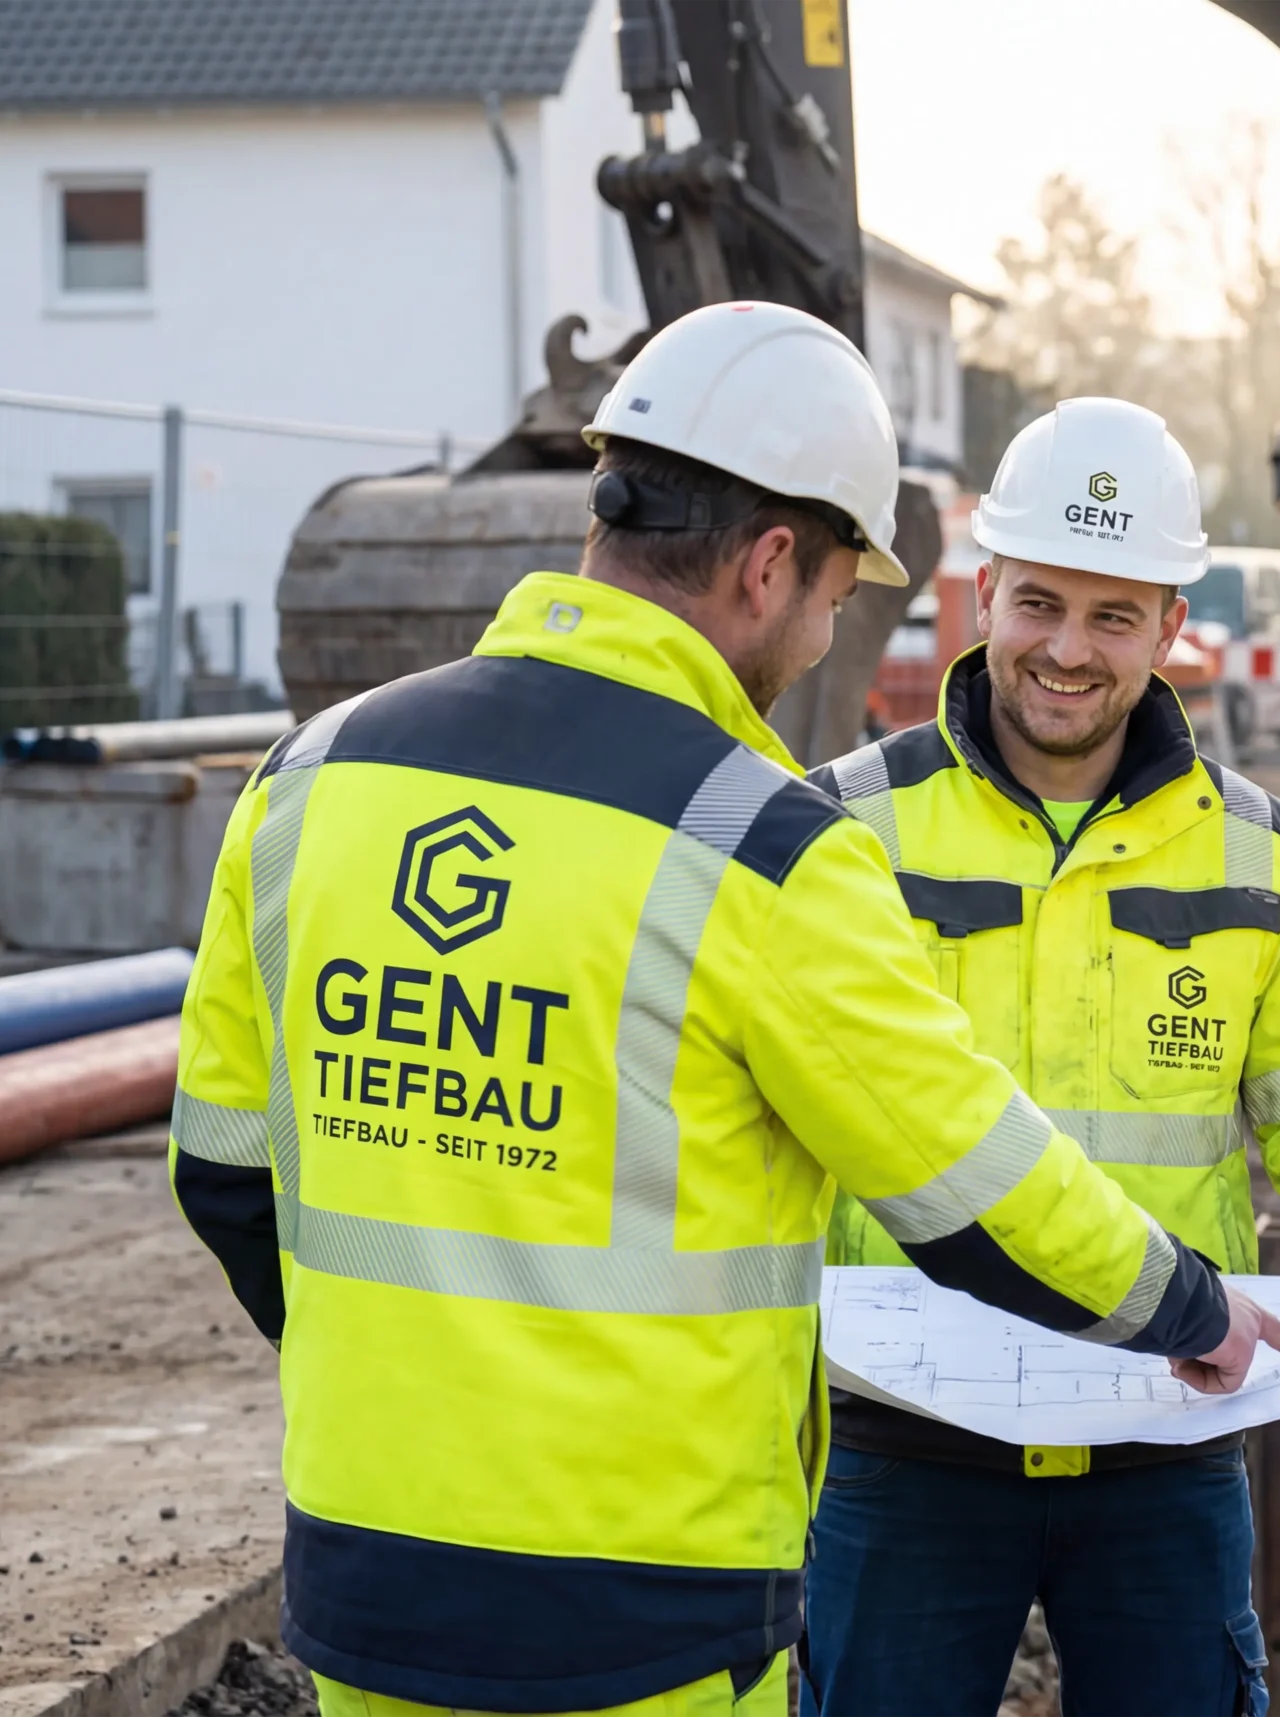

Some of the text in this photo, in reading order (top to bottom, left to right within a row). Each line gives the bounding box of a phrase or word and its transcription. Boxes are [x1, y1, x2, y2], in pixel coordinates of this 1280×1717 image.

[1065, 504, 1133, 532] GENT
[315, 958, 569, 1066] GENT
[1147, 1013, 1227, 1042] GENT
[1148, 1040, 1224, 1061] TIEFBAU
[314, 1050, 563, 1132] TIEFBAU
[313, 1113, 408, 1148] TIEFBAU
[435, 1133, 487, 1162] SEIT
[496, 1143, 558, 1172] 1972
